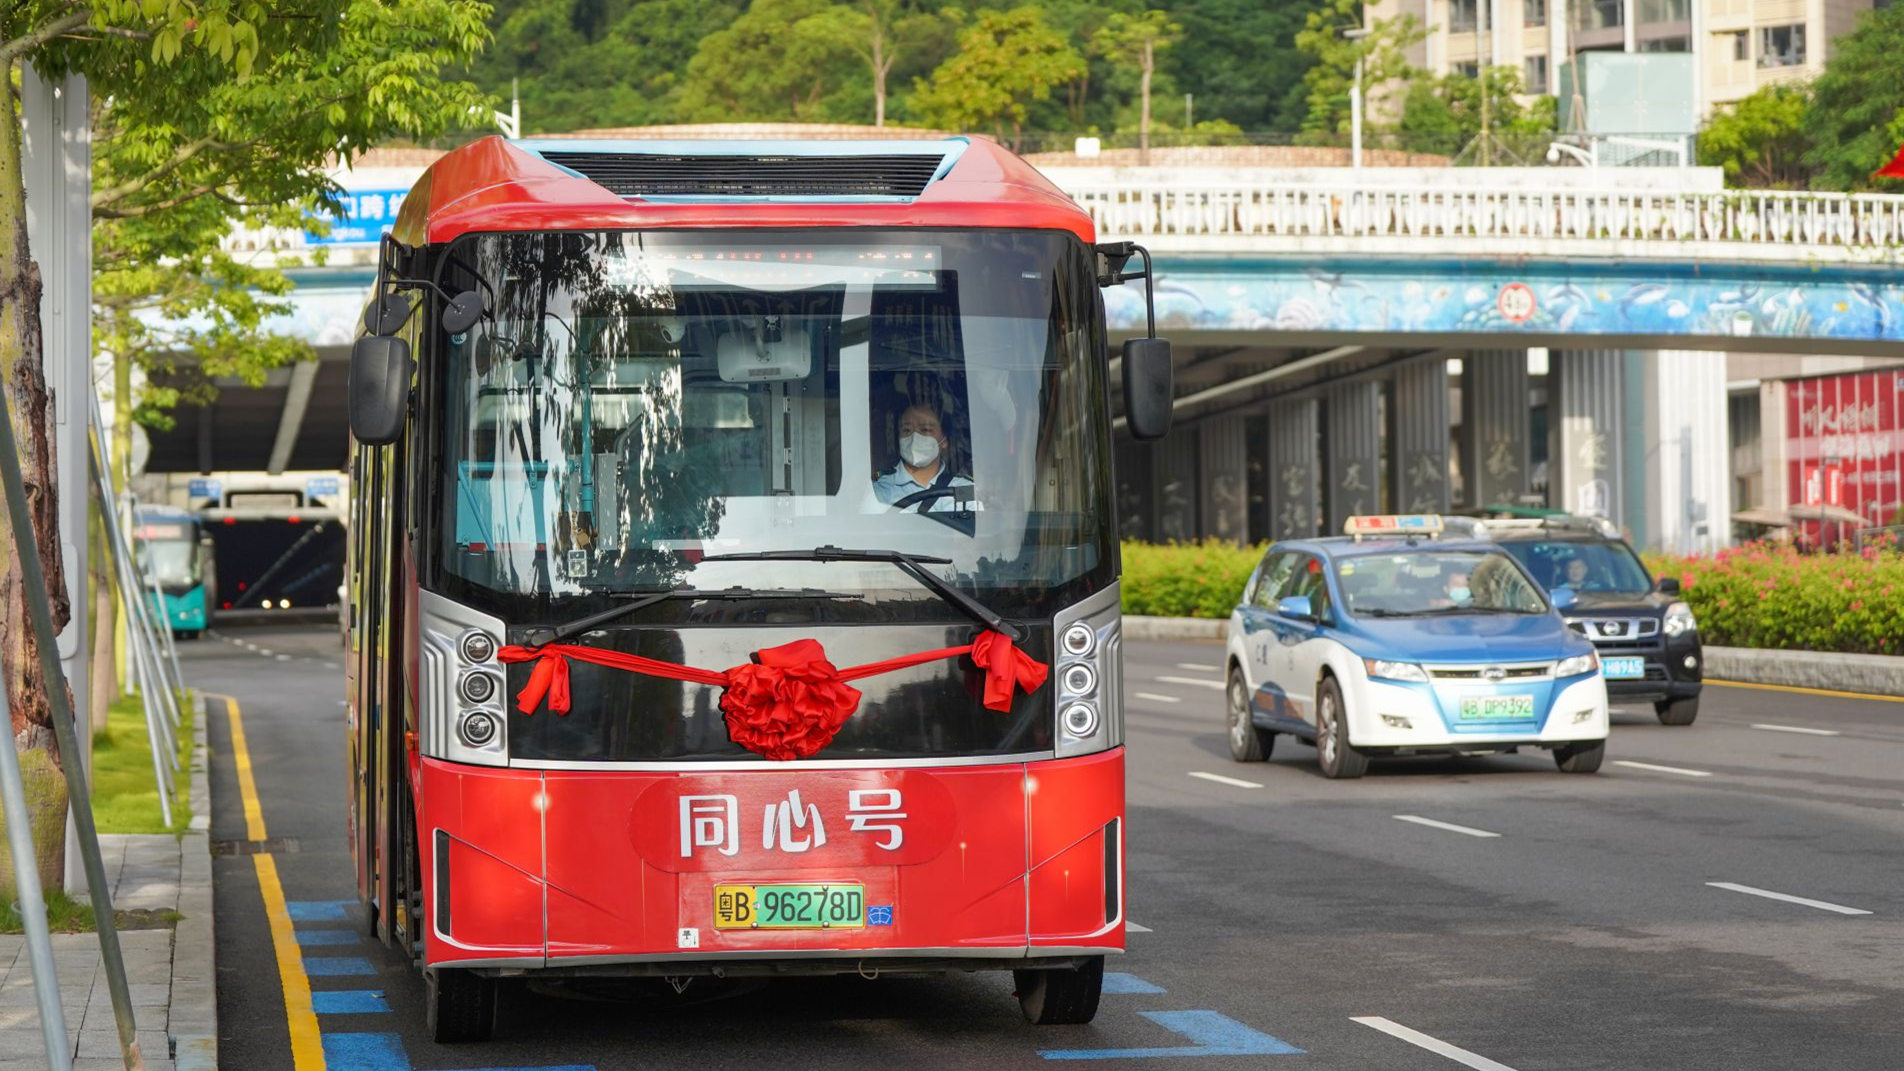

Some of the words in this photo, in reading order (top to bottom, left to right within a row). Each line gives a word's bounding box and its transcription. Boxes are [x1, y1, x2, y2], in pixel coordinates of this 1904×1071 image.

[1485, 699, 1531, 714] DP9392
[679, 789, 908, 858] 同心号
[764, 891, 861, 922] 96278D
